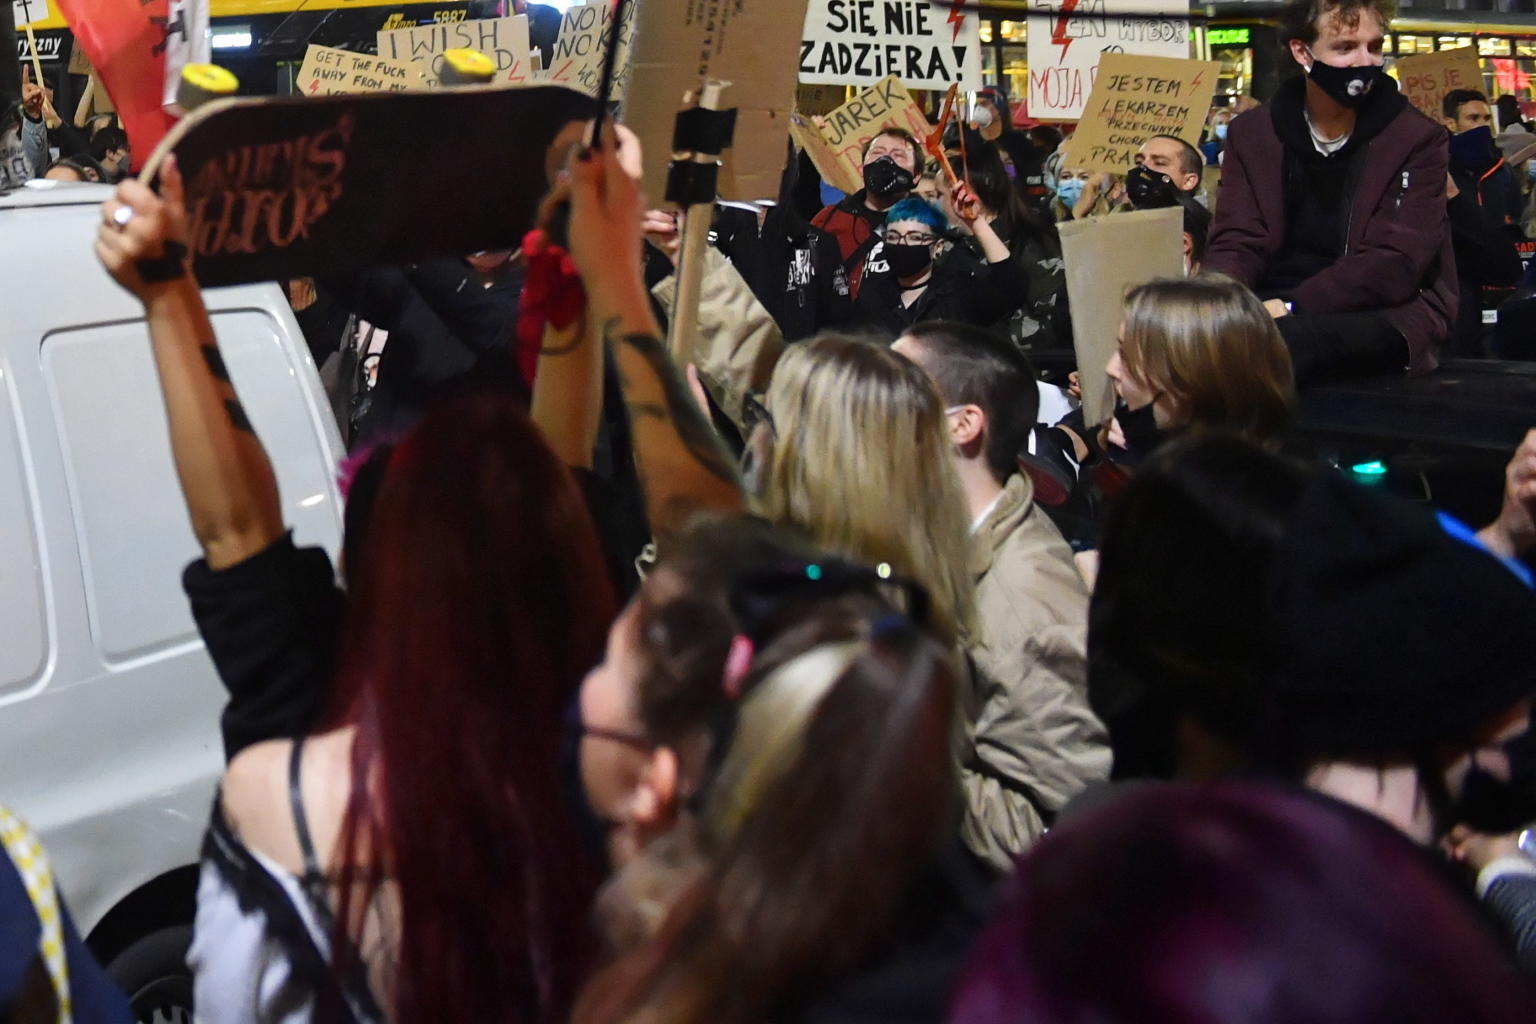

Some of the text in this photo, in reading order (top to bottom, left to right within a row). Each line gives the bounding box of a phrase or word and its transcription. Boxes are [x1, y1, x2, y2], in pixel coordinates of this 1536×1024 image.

[433, 9, 467, 25] 5887
[564, 7, 596, 33] NO
[390, 33, 397, 58] I
[410, 21, 498, 54] WISH
[556, 34, 592, 60] NO
[316, 50, 406, 78] GET THE FUCK
[312, 68, 347, 81] AWAY
[353, 75, 383, 89] FROM
[1030, 67, 1082, 109] MOJA
[1107, 75, 1181, 96] JESTEM
[1406, 74, 1436, 95] PIS
[824, 79, 905, 146] JAREK
[1102, 99, 1189, 119] LEKARZEM
